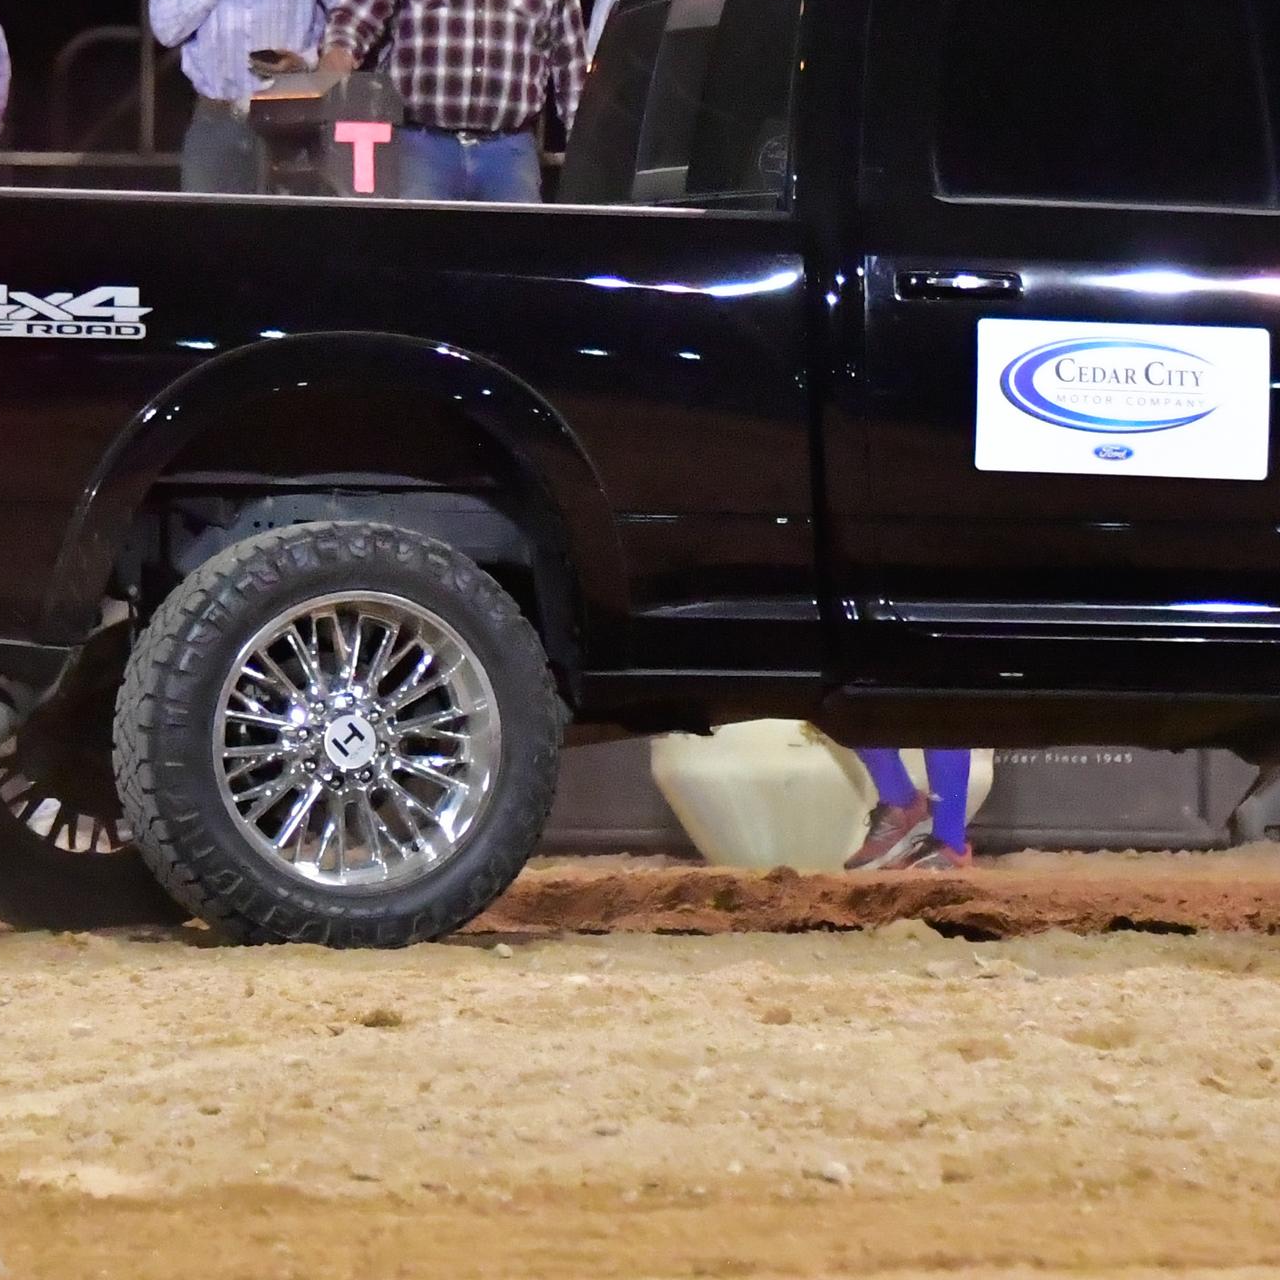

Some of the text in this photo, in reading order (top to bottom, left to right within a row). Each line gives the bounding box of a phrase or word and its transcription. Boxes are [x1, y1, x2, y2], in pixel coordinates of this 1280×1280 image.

[26, 323, 141, 336] ROAD
[1056, 394, 1206, 408] MOTOR COMPANY
